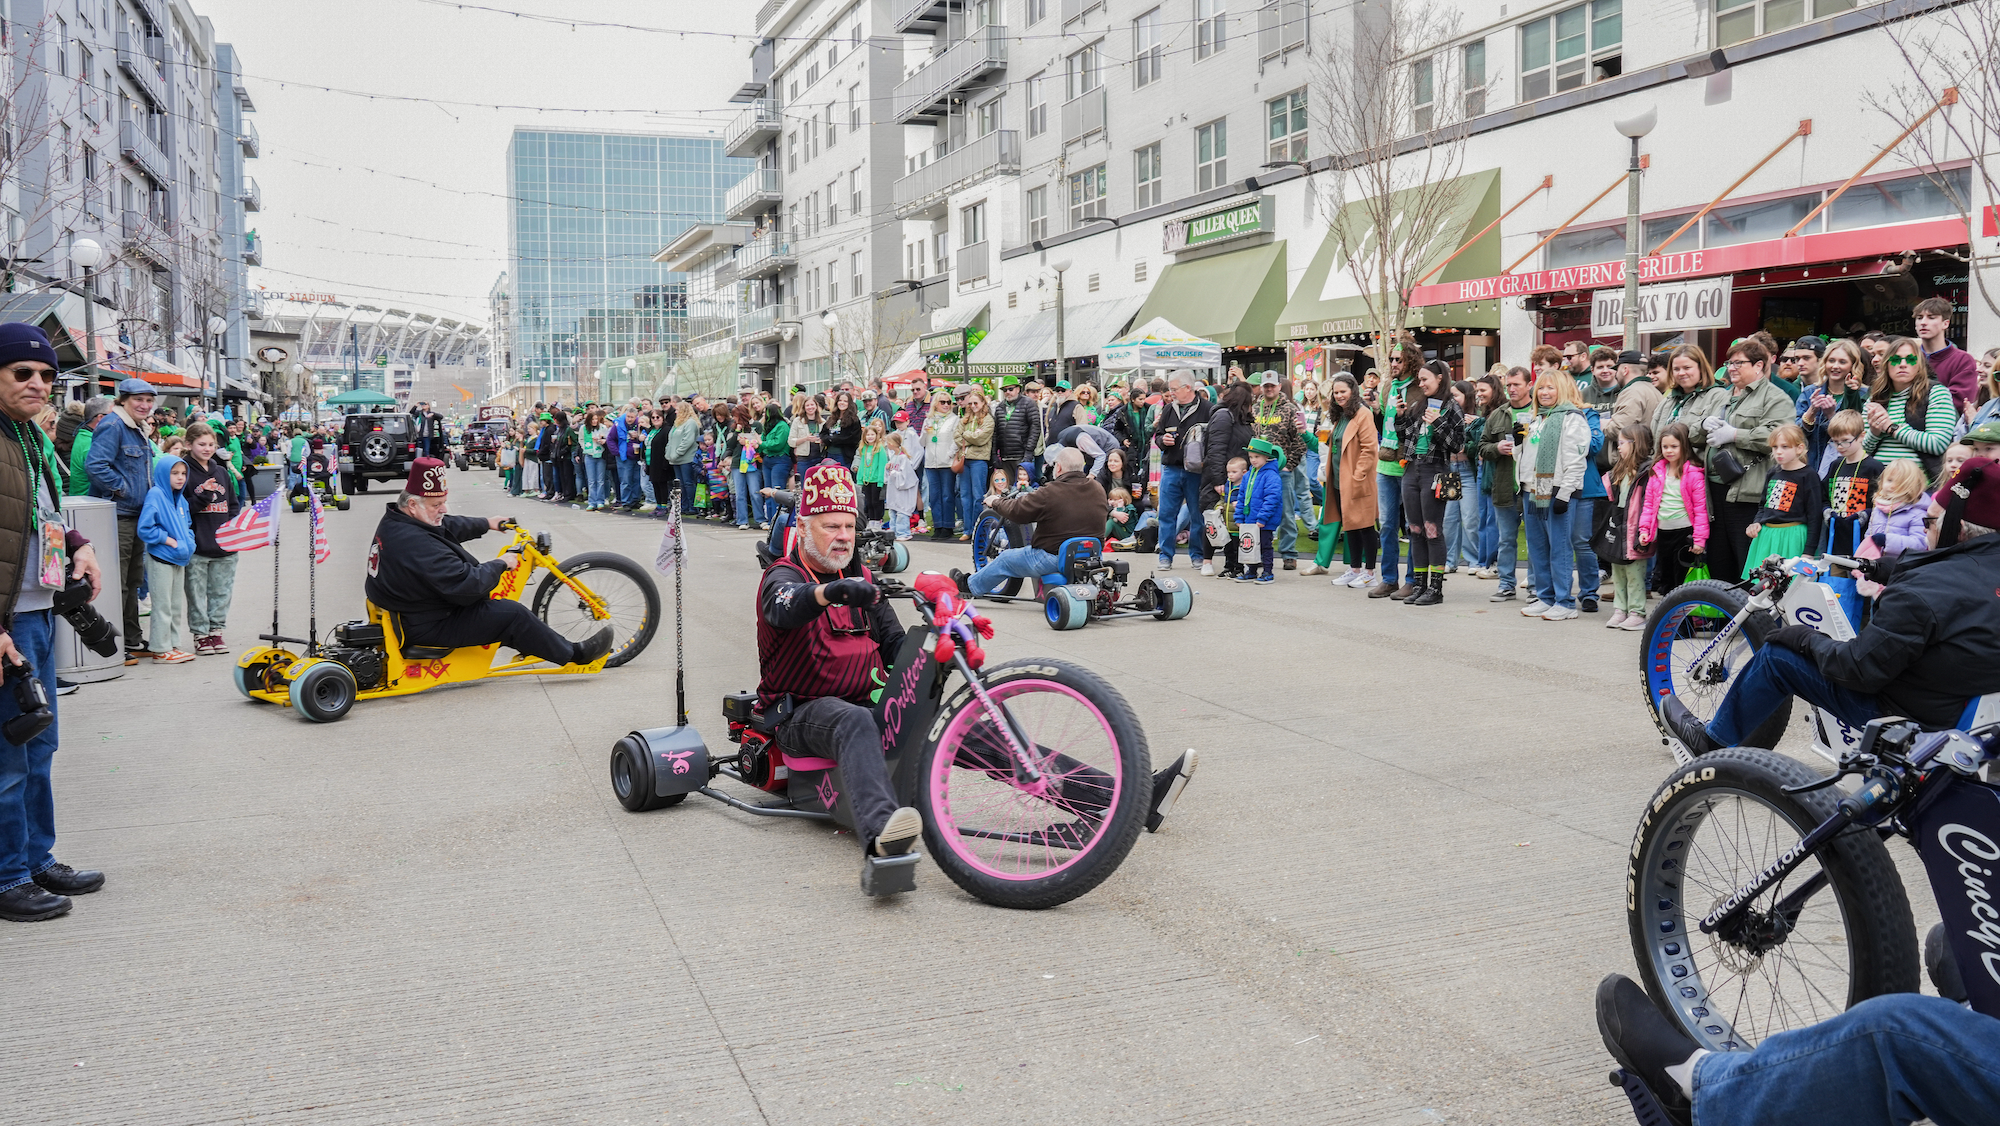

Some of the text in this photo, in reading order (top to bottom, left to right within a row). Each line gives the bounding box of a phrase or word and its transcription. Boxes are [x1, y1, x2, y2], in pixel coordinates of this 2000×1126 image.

[1192, 205, 1260, 237] KILLER QUEEN
[1459, 252, 1704, 299] HOLY GRAIL TAVERN & GRILLE
[289, 292, 336, 303] STADIUM
[1665, 291, 1688, 321] TO
[1695, 288, 1723, 318] GO
[1290, 324, 1308, 336] BEER
[1322, 318, 1363, 333] COCKTAILS
[921, 339, 932, 351] COLD
[932, 336, 949, 349] DRINKS
[927, 364, 1027, 375] COLD DRINKS HERE
[811, 505, 829, 514] PAST
[1685, 619, 1737, 674] CINCINNATI,OH
[1627, 767, 1716, 911] CST BFT 26x4.0
[1704, 841, 1806, 927] CINCINNATI,OH
